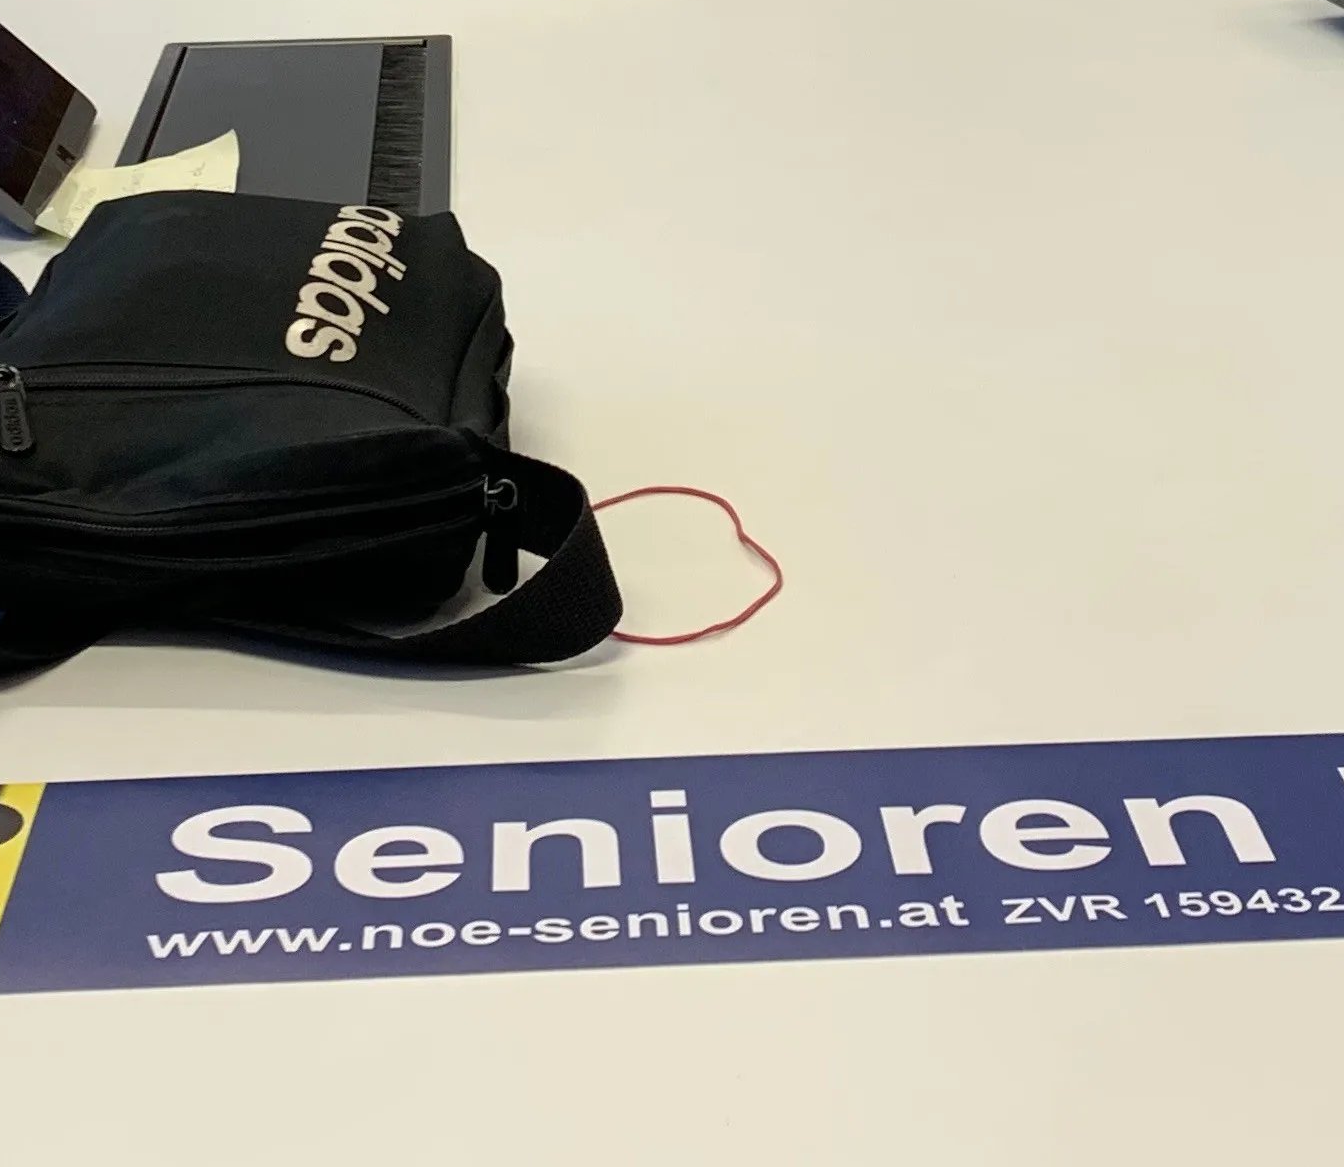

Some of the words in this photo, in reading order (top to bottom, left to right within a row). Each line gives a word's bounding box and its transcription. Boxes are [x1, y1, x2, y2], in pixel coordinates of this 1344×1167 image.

[285, 205, 407, 362] adidas
[156, 790, 1276, 905] Senioren
[146, 895, 970, 959] www.noe-senioren.at
[1001, 895, 1128, 925] ZVR
